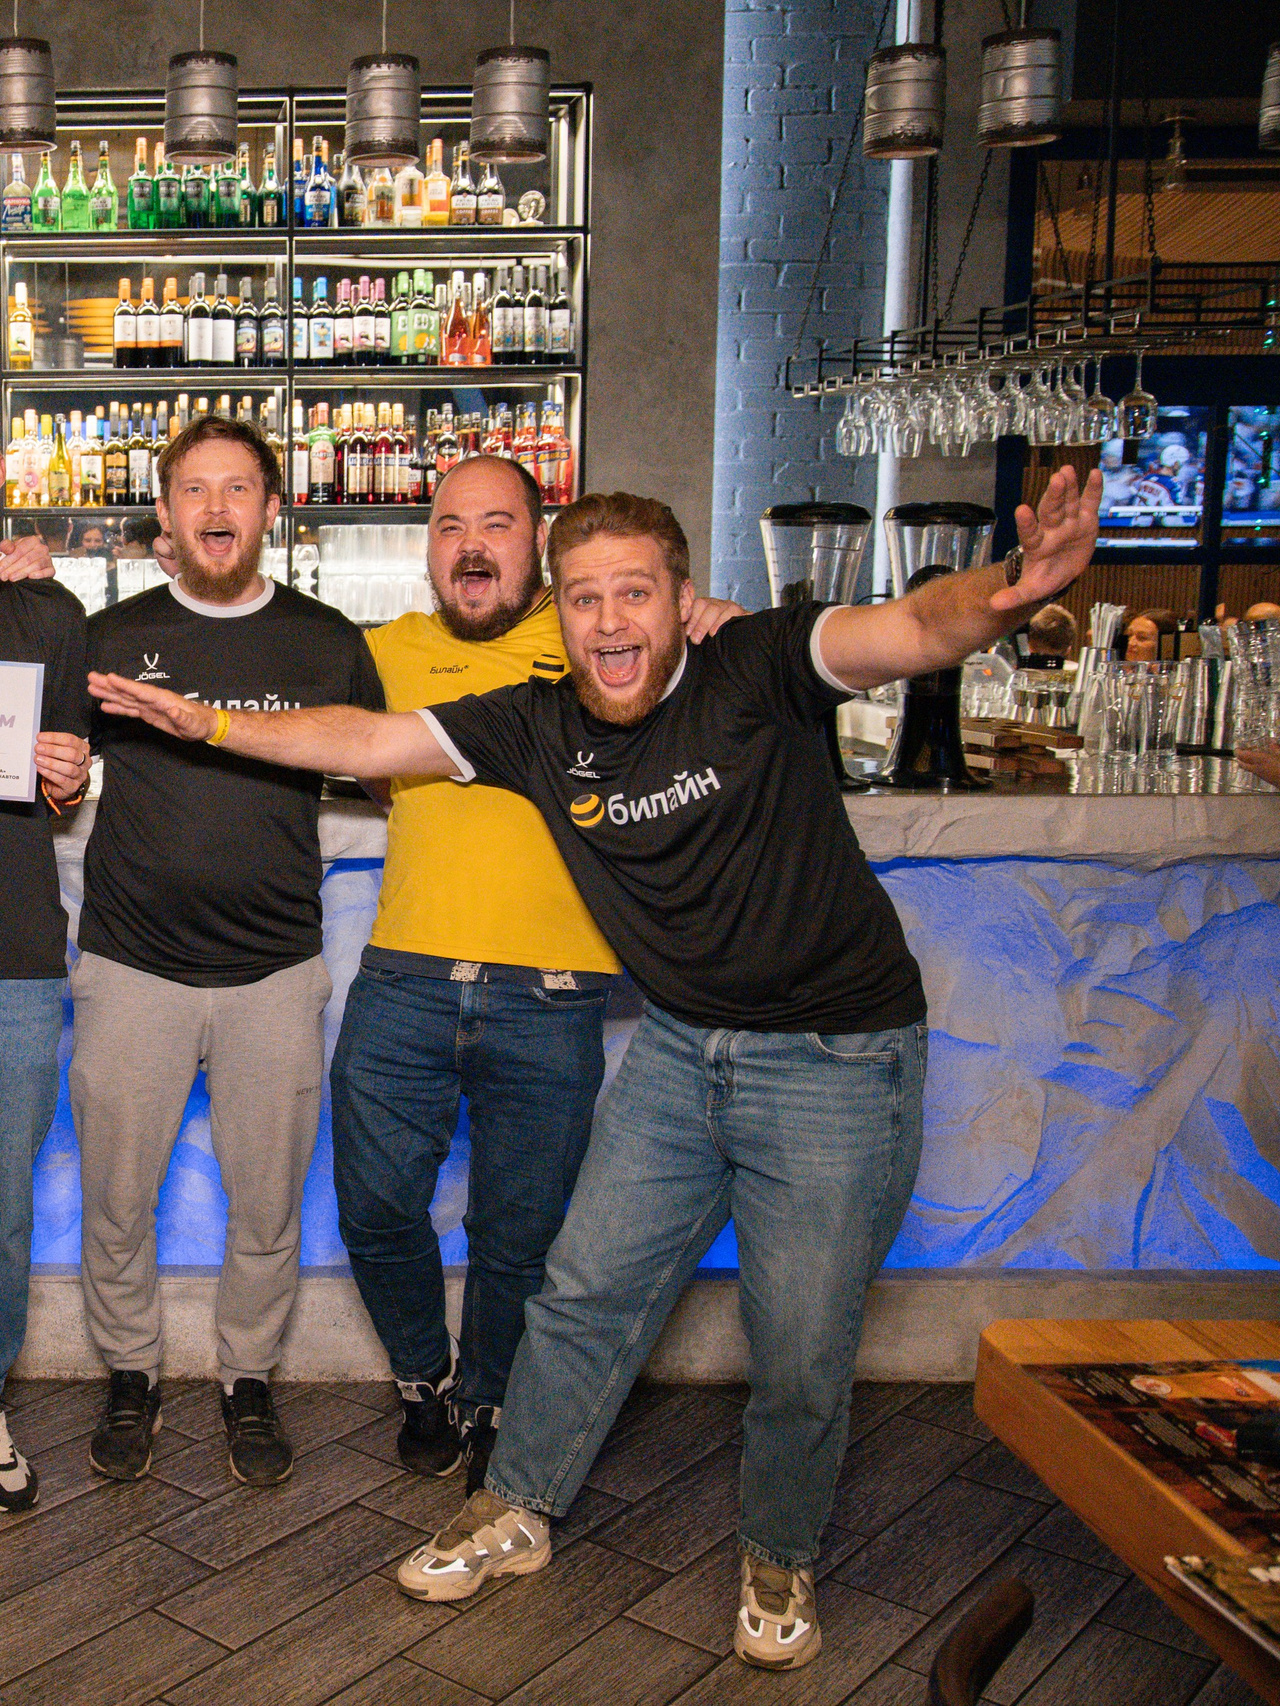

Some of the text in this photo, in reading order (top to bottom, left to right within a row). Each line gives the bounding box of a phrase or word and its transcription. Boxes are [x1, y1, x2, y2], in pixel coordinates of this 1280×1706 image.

[135, 671, 170, 681] JÖGEL
[566, 766, 601, 779] JÖGEL
[607, 766, 721, 826] билайн
